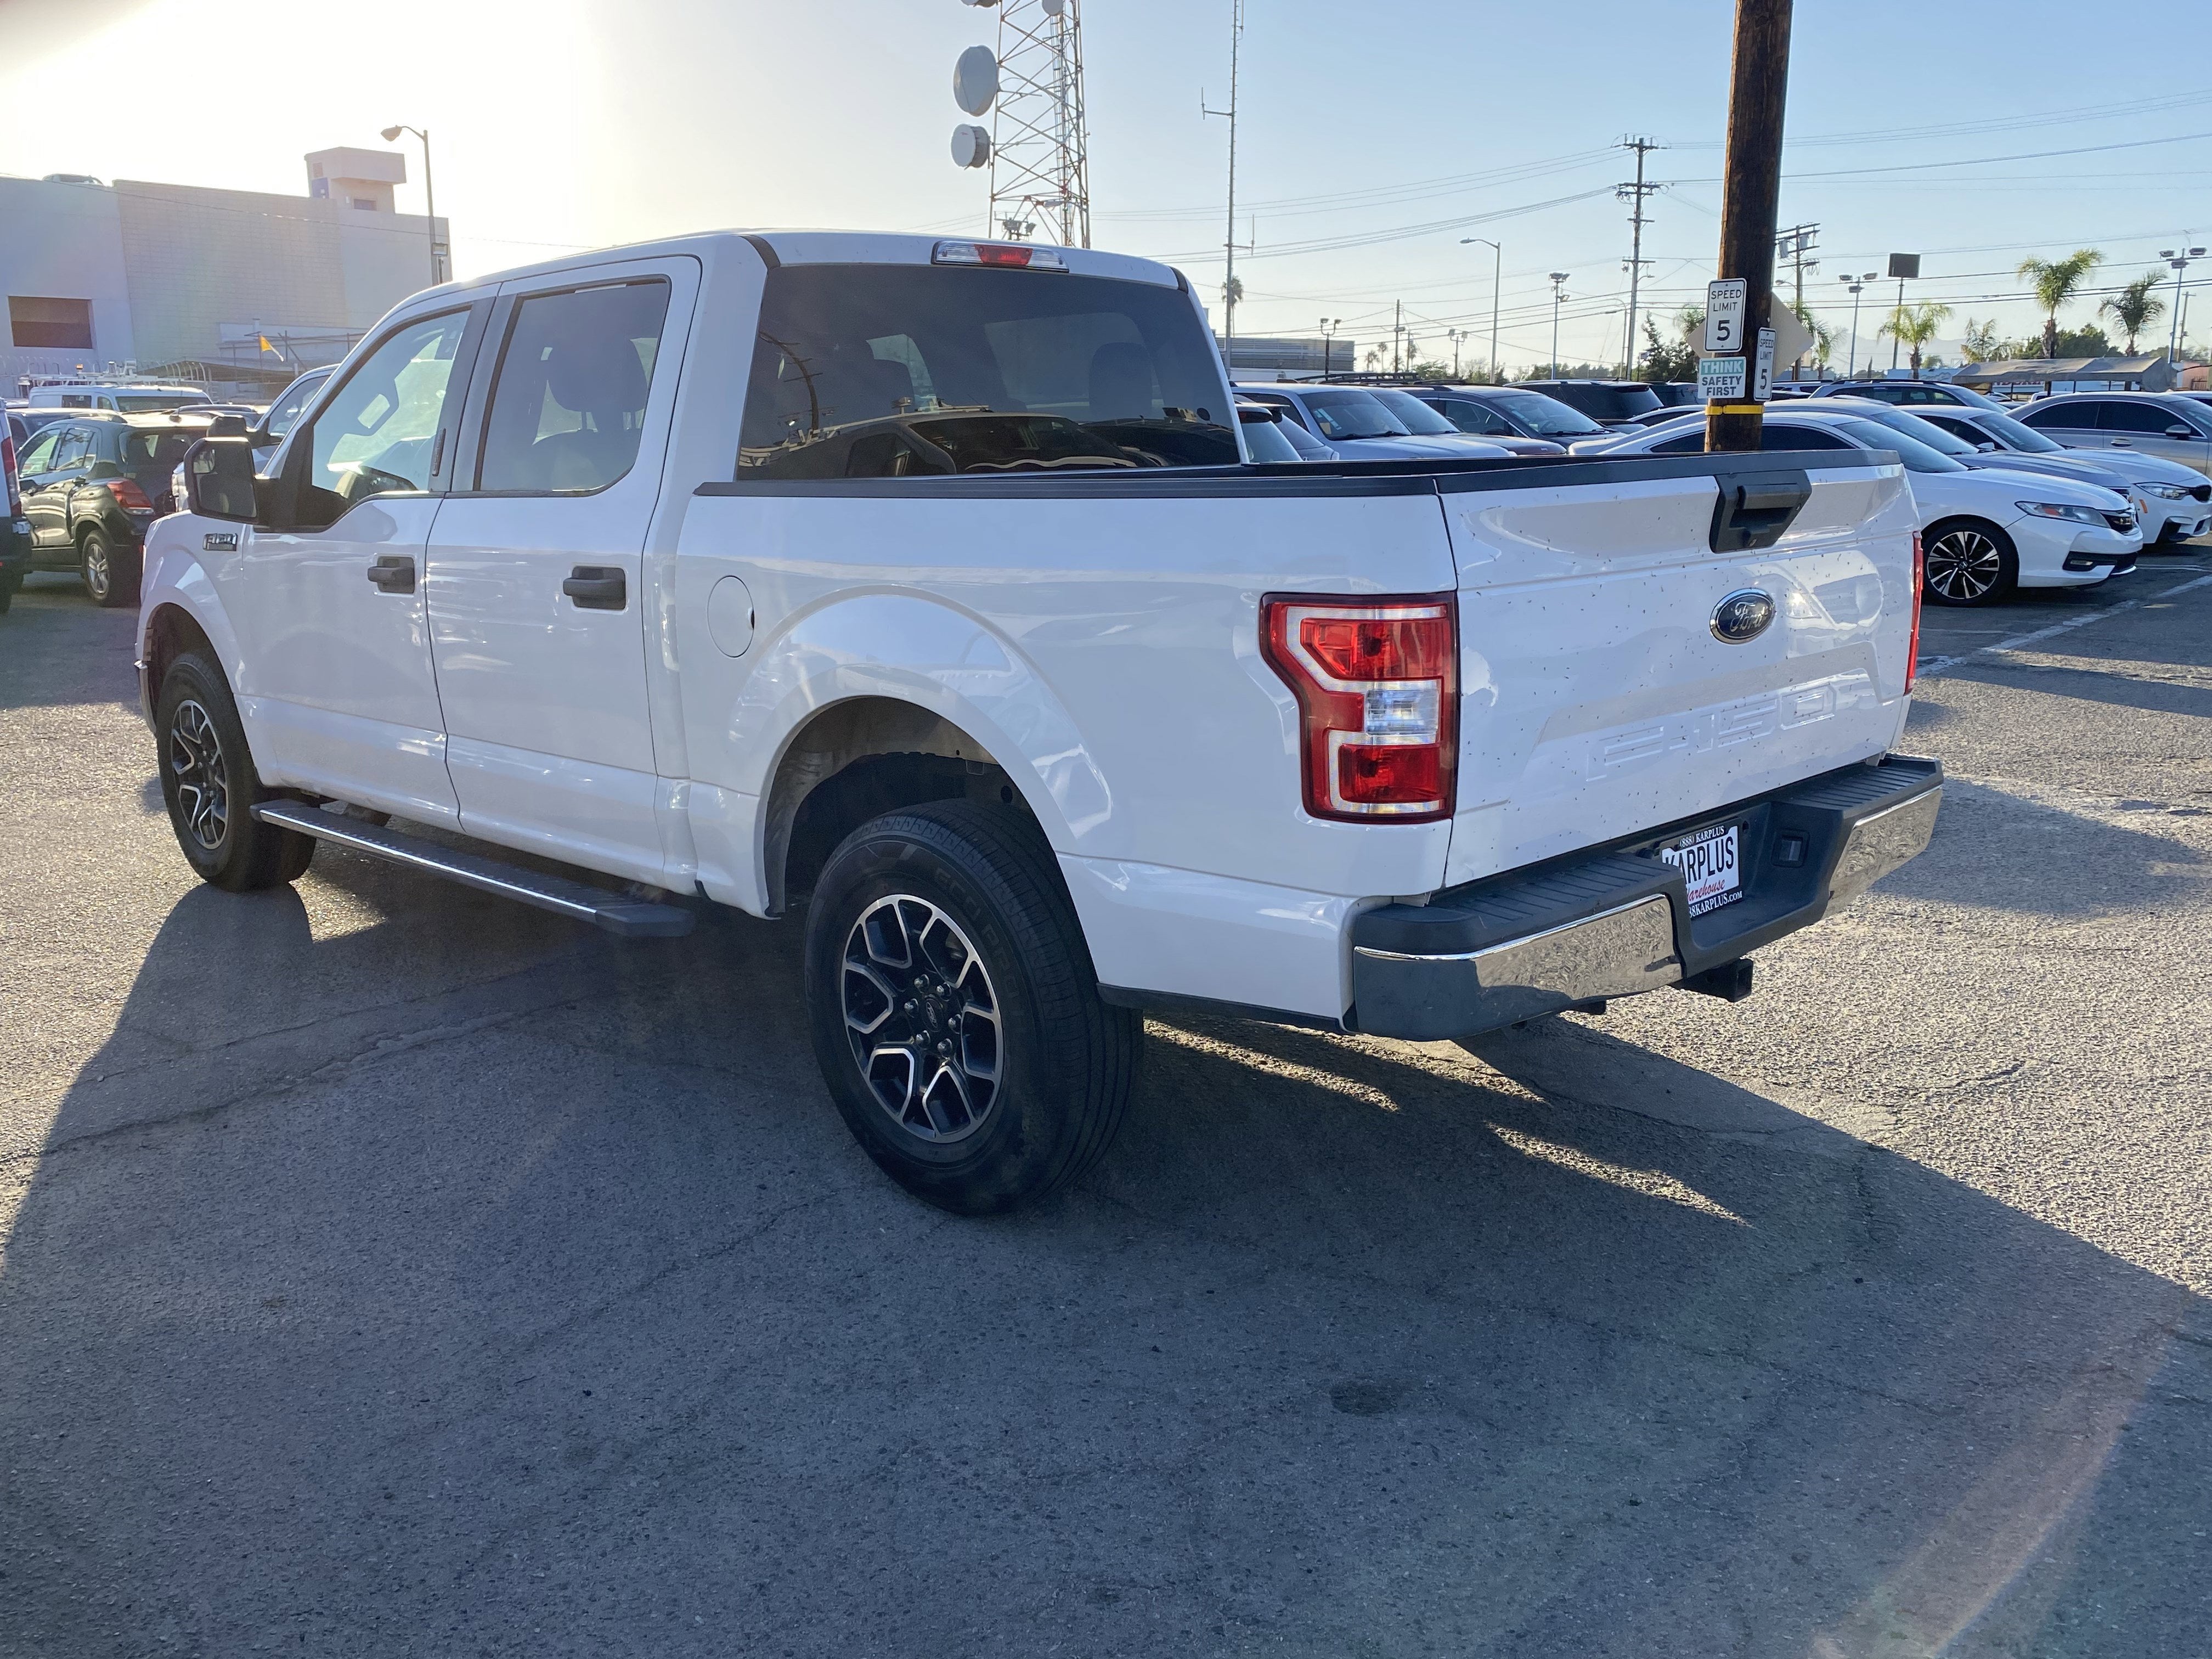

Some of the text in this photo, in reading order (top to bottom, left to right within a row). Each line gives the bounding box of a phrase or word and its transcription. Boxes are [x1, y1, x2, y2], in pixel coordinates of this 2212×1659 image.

[1711, 290, 1741, 299] SPEED
[1713, 302, 1737, 312] LIMIT
[1717, 320, 1730, 341] 5
[1760, 338, 1774, 348] SPEED
[1760, 351, 1771, 360] LIMIT
[1703, 361, 1742, 373] THINK
[1702, 376, 1742, 386] SAFETY
[1760, 369, 1768, 390] 5
[1707, 386, 1736, 396] FIRST
[1680, 826, 1724, 848] (888) KARPLUS
[1687, 878, 1725, 901] arehouse
